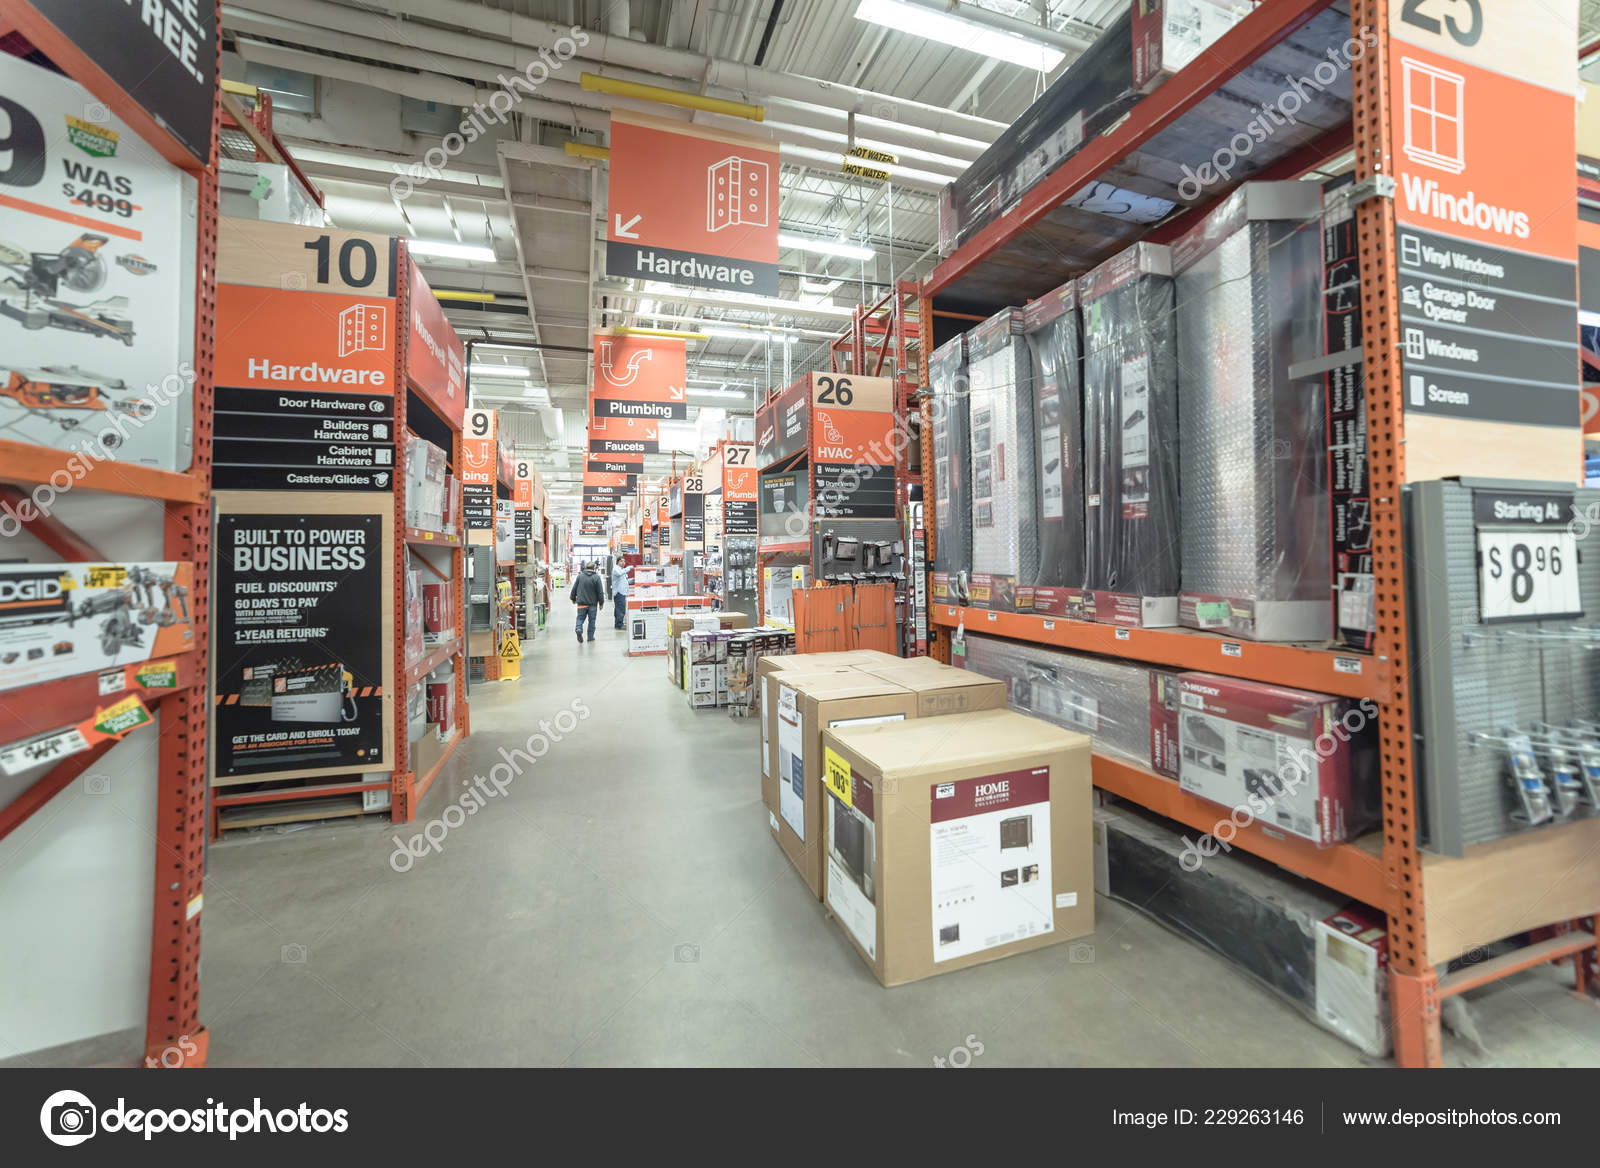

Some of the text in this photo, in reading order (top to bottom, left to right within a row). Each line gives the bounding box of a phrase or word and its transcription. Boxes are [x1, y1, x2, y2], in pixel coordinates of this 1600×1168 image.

[126, 0, 204, 84] REE.
[868, 150, 894, 163] WATER
[62, 158, 133, 196] WAS
[845, 164, 887, 180] HOT WATER
[62, 182, 134, 218] $499
[1401, 172, 1530, 239] Windows
[304, 235, 377, 288] 10
[636, 250, 755, 286] Hardware
[1422, 245, 1504, 278] Vinyl Windows
[1422, 282, 1496, 311] Garage Door
[1423, 300, 1468, 323] Opener
[1426, 337, 1479, 362] Windows
[248, 358, 386, 386] Hardware
[817, 376, 853, 405] 26
[1428, 384, 1469, 405] Screen
[279, 397, 366, 410] Door Hardware
[610, 402, 672, 418] Plumbing
[323, 420, 369, 431] Builders
[471, 412, 489, 436] 9
[314, 429, 369, 441] Hardware
[329, 446, 372, 456] Cabinet
[605, 441, 645, 451] Faucets
[818, 447, 853, 460] HVAC
[317, 455, 372, 466] Hardware
[727, 447, 749, 465] 27
[517, 462, 529, 478] 8
[605, 463, 626, 471] Paint
[287, 473, 370, 485] Casters/Glides
[686, 479, 703, 491] 28
[1494, 500, 1560, 523] Starting At
[234, 529, 366, 545] BUILT TO POWER
[234, 546, 366, 572] BUSINESS
[235, 583, 265, 593] FUEL
[235, 597, 319, 609] 60 DAYS TO PAY
[234, 629, 275, 640] 1-YEAR
[232, 728, 360, 744] GET THE CARD AND ENROLL TODAY
[832, 769, 845, 794] 103
[975, 781, 1009, 797] HOME
